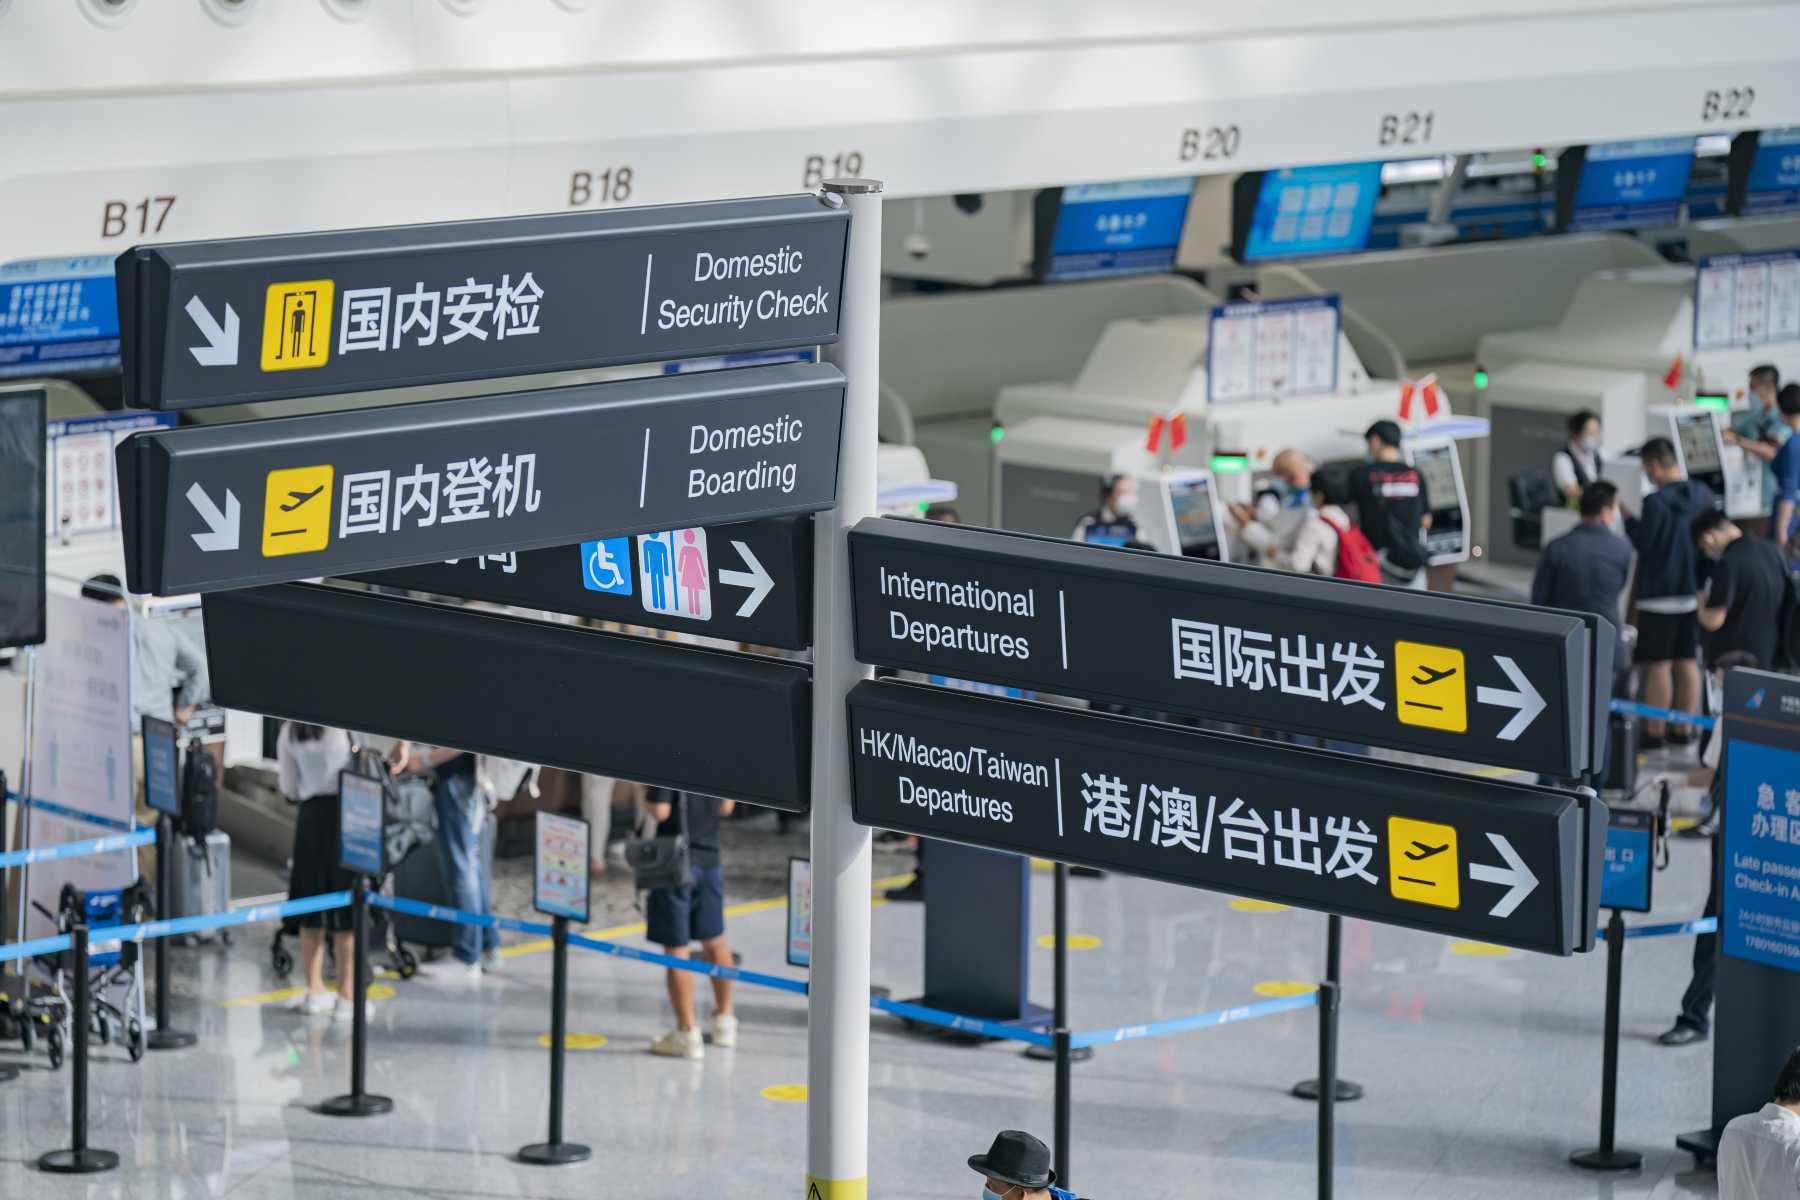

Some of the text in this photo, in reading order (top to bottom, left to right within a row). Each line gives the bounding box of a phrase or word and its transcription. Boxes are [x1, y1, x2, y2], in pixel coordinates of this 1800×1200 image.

[1701, 87, 1756, 122] B22
[1179, 123, 1242, 162] B20
[1378, 111, 1435, 147] B21
[569, 167, 635, 207] B18
[802, 151, 863, 188] B19
[101, 195, 177, 239] B17
[694, 245, 803, 282] Domestic
[338, 271, 545, 355] 国内安检
[657, 285, 829, 331] Security Check
[689, 414, 803, 455] Domestic
[338, 453, 542, 539] 国内登机
[687, 460, 797, 498] Boarding
[880, 566, 1035, 618] International
[889, 610, 1030, 660] Departures
[1171, 617, 1386, 711] 国际出发
[860, 727, 1049, 788] HK/Macao/Taiwan
[898, 776, 1014, 823] Departures
[1080, 772, 1379, 886] 港/澳/台出发
[1733, 851, 1800, 881] Late passe
[1734, 871, 1789, 899] Check-in
